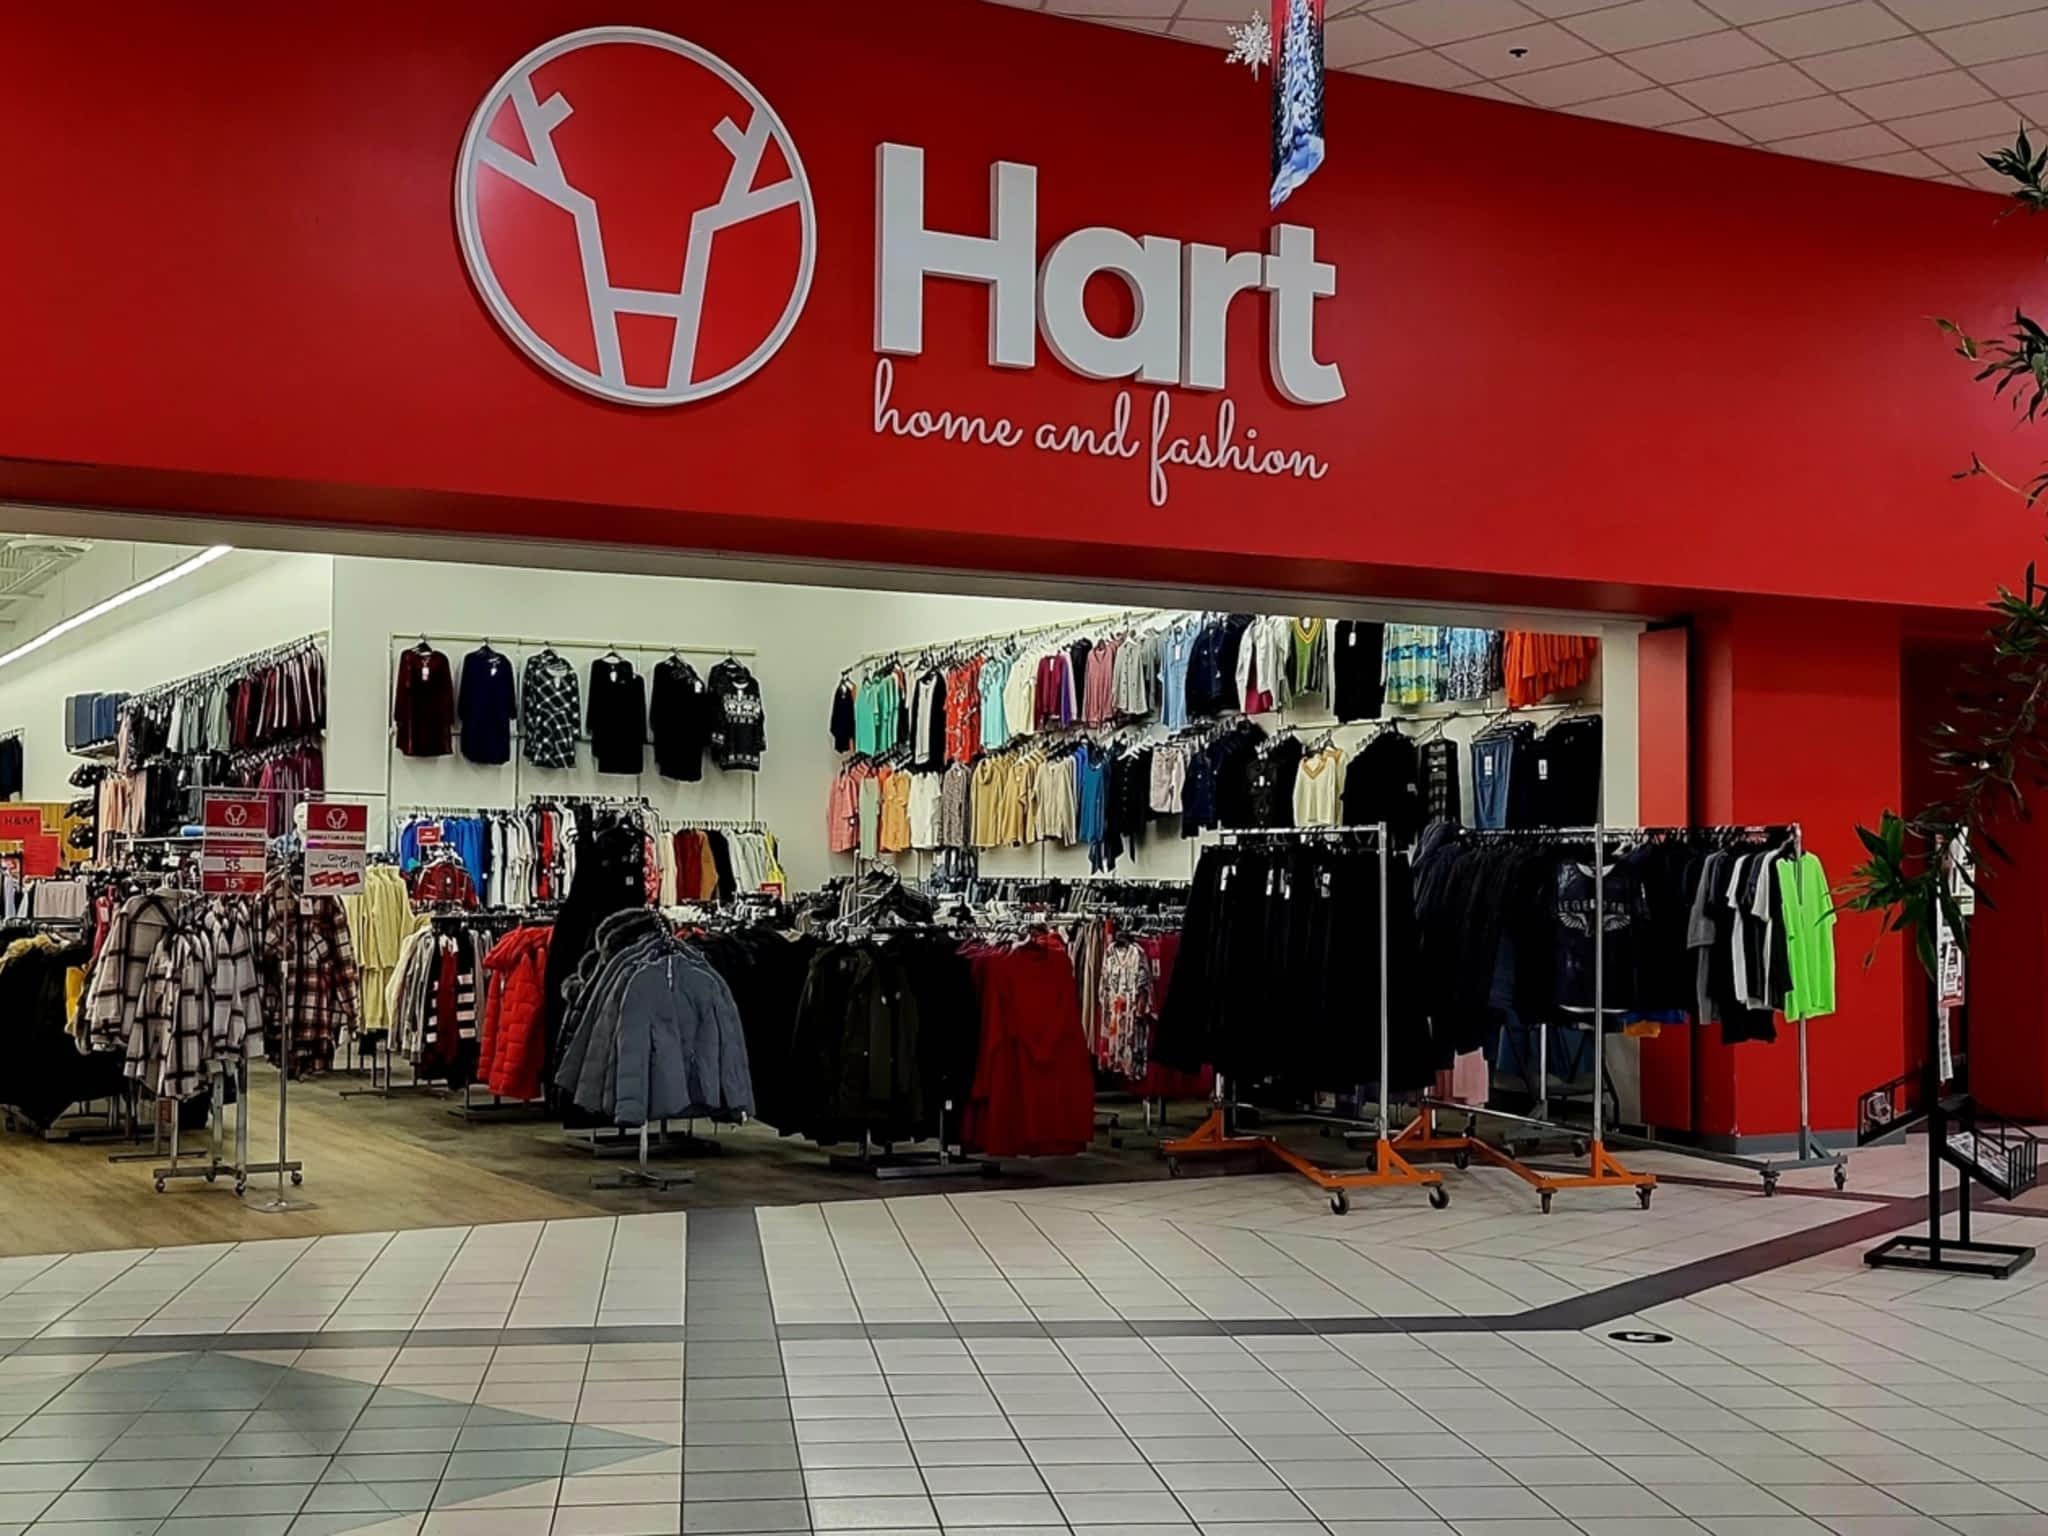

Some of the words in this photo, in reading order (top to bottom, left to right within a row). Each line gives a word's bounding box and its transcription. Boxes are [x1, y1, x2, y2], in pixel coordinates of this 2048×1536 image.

[873, 142, 1346, 405] Hart
[874, 358, 1023, 447] home
[1035, 391, 1140, 458] and
[1150, 391, 1328, 506] fashion
